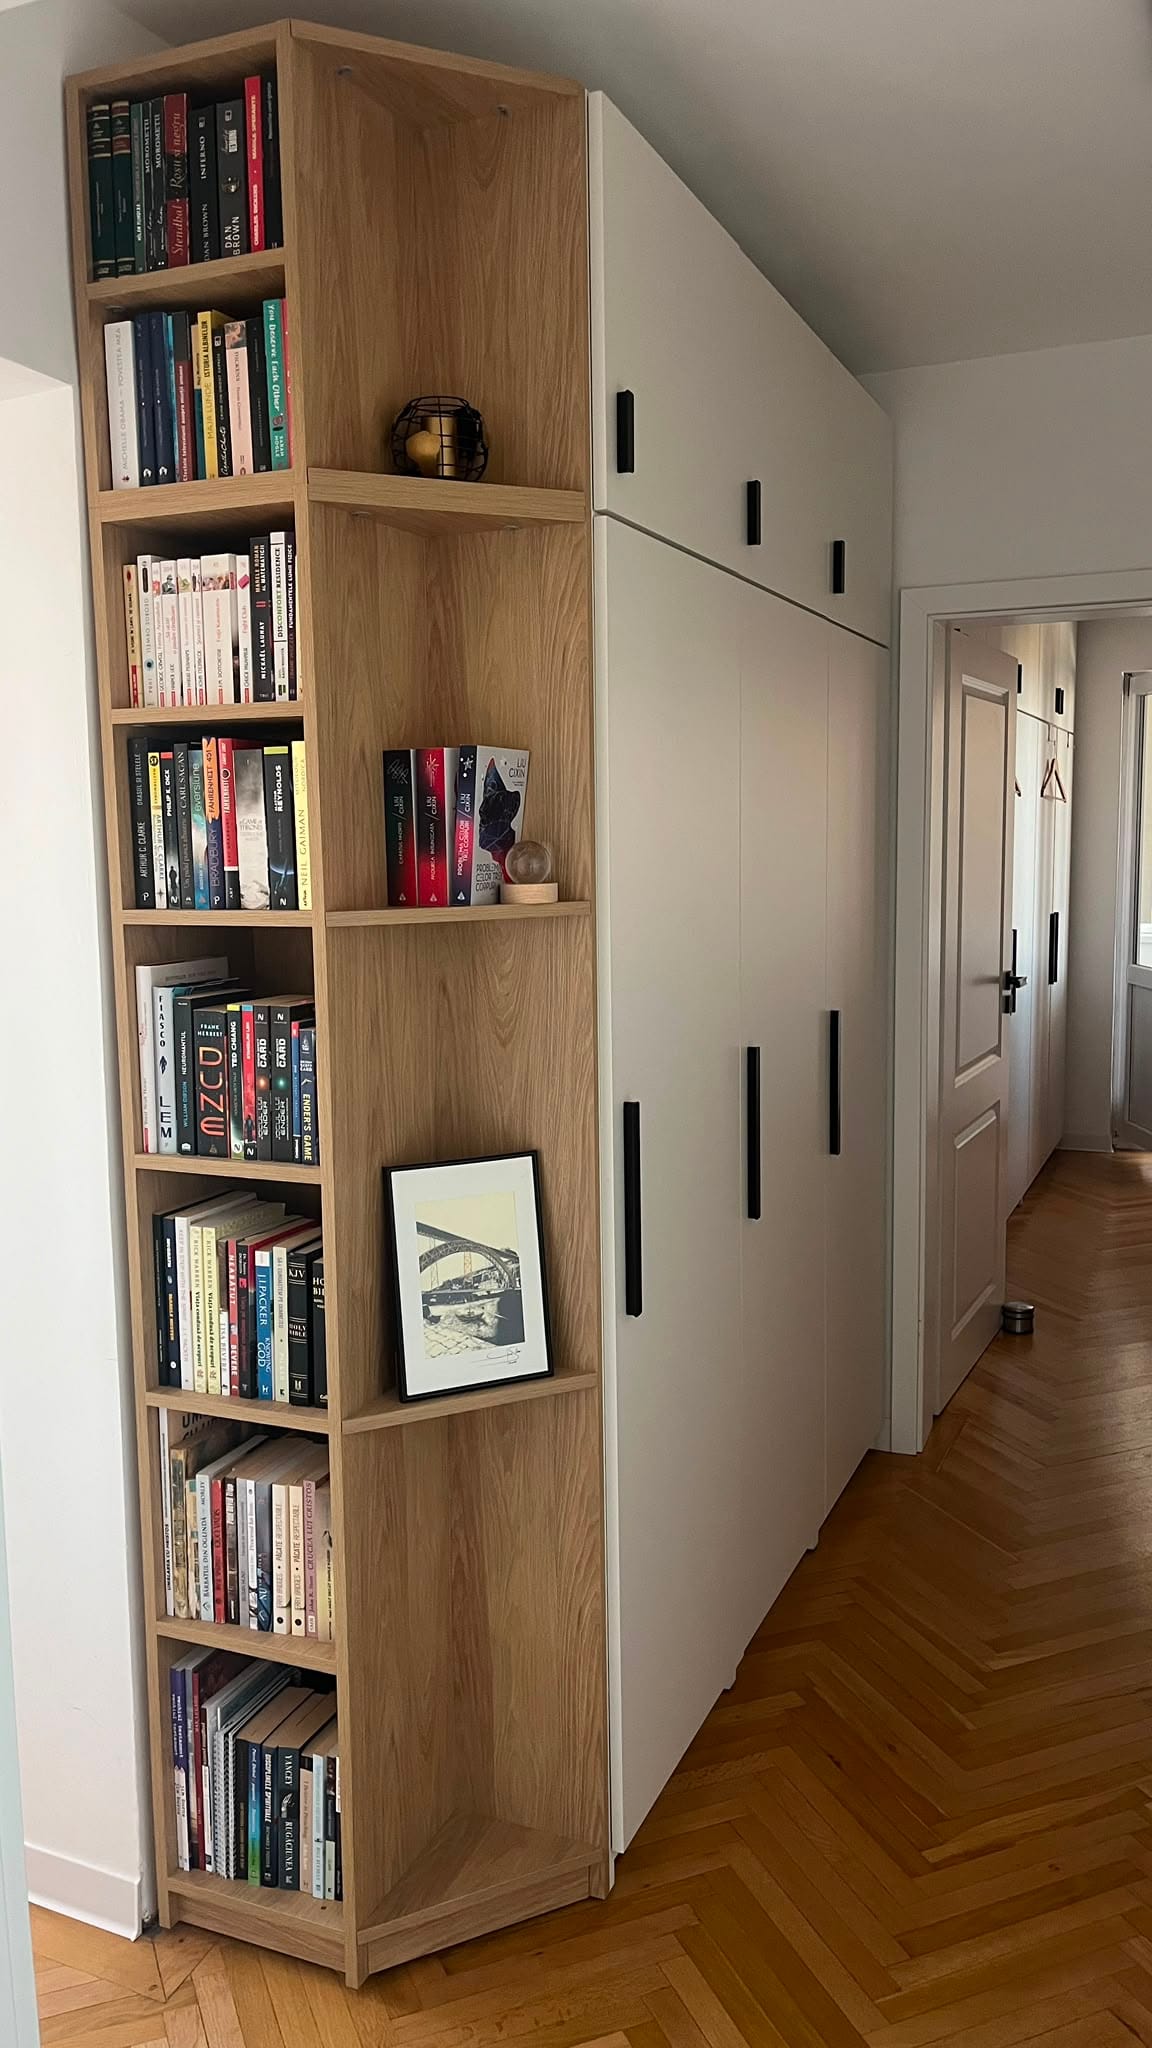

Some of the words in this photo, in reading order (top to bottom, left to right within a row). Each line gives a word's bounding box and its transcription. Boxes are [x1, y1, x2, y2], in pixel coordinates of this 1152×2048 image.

[200, 136, 208, 180] INFERNO
[201, 204, 210, 238] BROWN
[232, 216, 241, 255] BROWN
[203, 241, 211, 261] DAN
[224, 226, 233, 248] DAN
[114, 327, 122, 346] MEA
[200, 320, 209, 353] ALBINELOR
[116, 347, 124, 386] POVESTEA
[202, 354, 210, 378] ISTORIA
[268, 304, 276, 320] You
[272, 384, 281, 412] Other
[204, 382, 213, 413] LUNDE
[118, 400, 126, 430] OBAMA
[206, 415, 214, 440] MAJA
[120, 432, 129, 470] MICHELLE
[274, 548, 282, 589] RESIDENCE
[258, 621, 266, 648] LAUNAY
[177, 751, 186, 784] SAGAN
[508, 768, 525, 778] CIXIN
[516, 758, 526, 768] LIU
[178, 784, 188, 808] CARL
[207, 766, 215, 813] FAHRENHEIT
[275, 764, 284, 812] REYNOLDS
[136, 821, 146, 844] CLARKE
[156, 814, 164, 844] ARTHUR
[298, 808, 307, 855] GAIMAN
[138, 854, 148, 878] ARTHUR
[208, 828, 220, 886] BRADBURY
[300, 862, 308, 886] NEIL
[158, 994, 166, 1048] FIASCO
[230, 1021, 238, 1050] CHIANG
[278, 1038, 286, 1068] CARD
[160, 1095, 172, 1139] LEM
[302, 1094, 312, 1132] ENDER'S
[303, 1134, 312, 1161] GAME
[288, 1268, 306, 1279] KJV
[210, 1336, 216, 1344] de
[257, 1342, 266, 1368] GOD
[264, 1338, 272, 1373] KNOWING
[208, 1344, 216, 1368] scopuri
[230, 1344, 238, 1376] BEVERE
[305, 1482, 313, 1518] CRISTOS
[306, 1519, 314, 1534] LUI
[306, 1537, 314, 1570] CRUCEA
[258, 1587, 267, 1600] NU
[284, 1754, 293, 1786] YANCEY
[264, 1790, 272, 1823] SPIRITUALE
[284, 1821, 295, 1871] RUGĂCIUNEA
